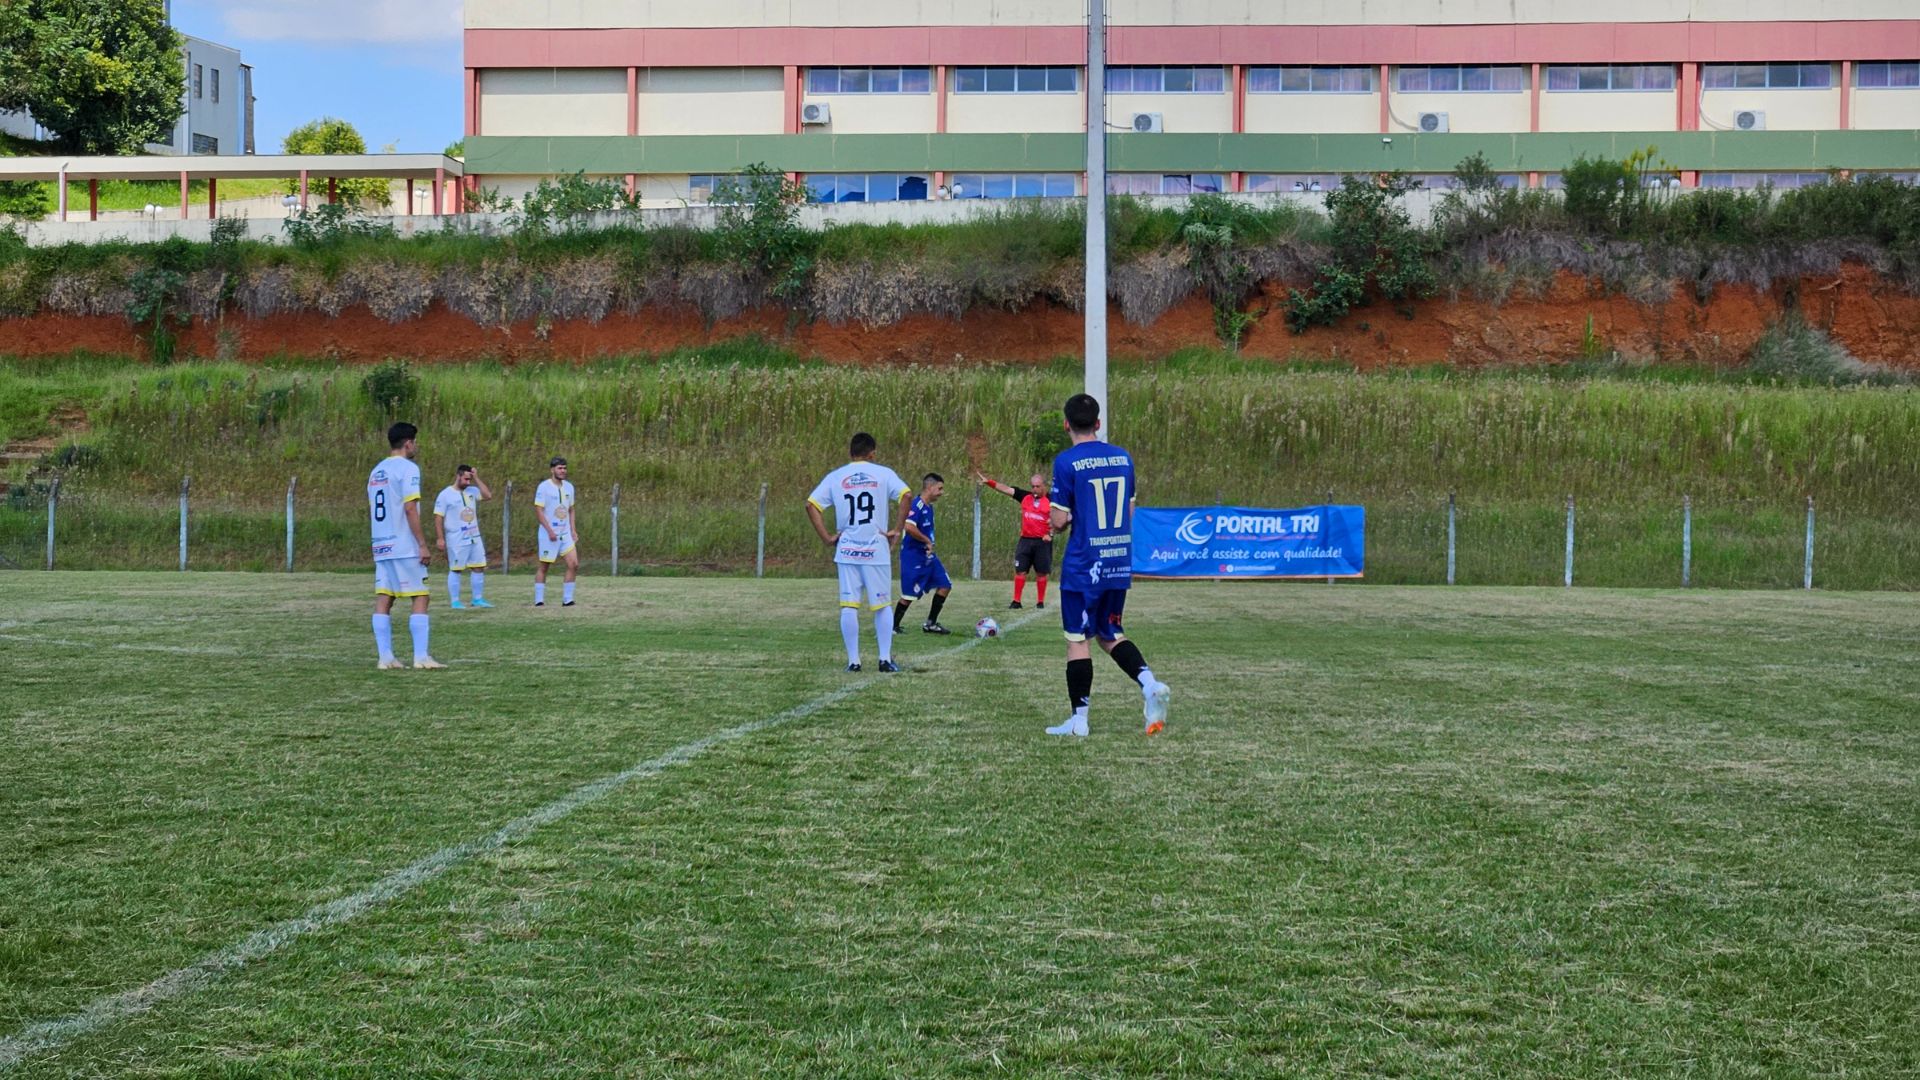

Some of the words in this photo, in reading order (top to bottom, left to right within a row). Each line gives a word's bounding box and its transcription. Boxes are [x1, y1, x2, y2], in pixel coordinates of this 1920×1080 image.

[375, 489, 386, 522] 8
[843, 491, 875, 526] 19
[1088, 476, 1125, 529] 17
[1215, 515, 1286, 534] PORTAL
[1290, 515, 1320, 533] TRI
[1150, 547, 1180, 563] Aqui
[1182, 547, 1209, 560] você
[1212, 547, 1250, 560] assiste
[1253, 550, 1280, 559] com
[1283, 546, 1343, 562] qualidade!
